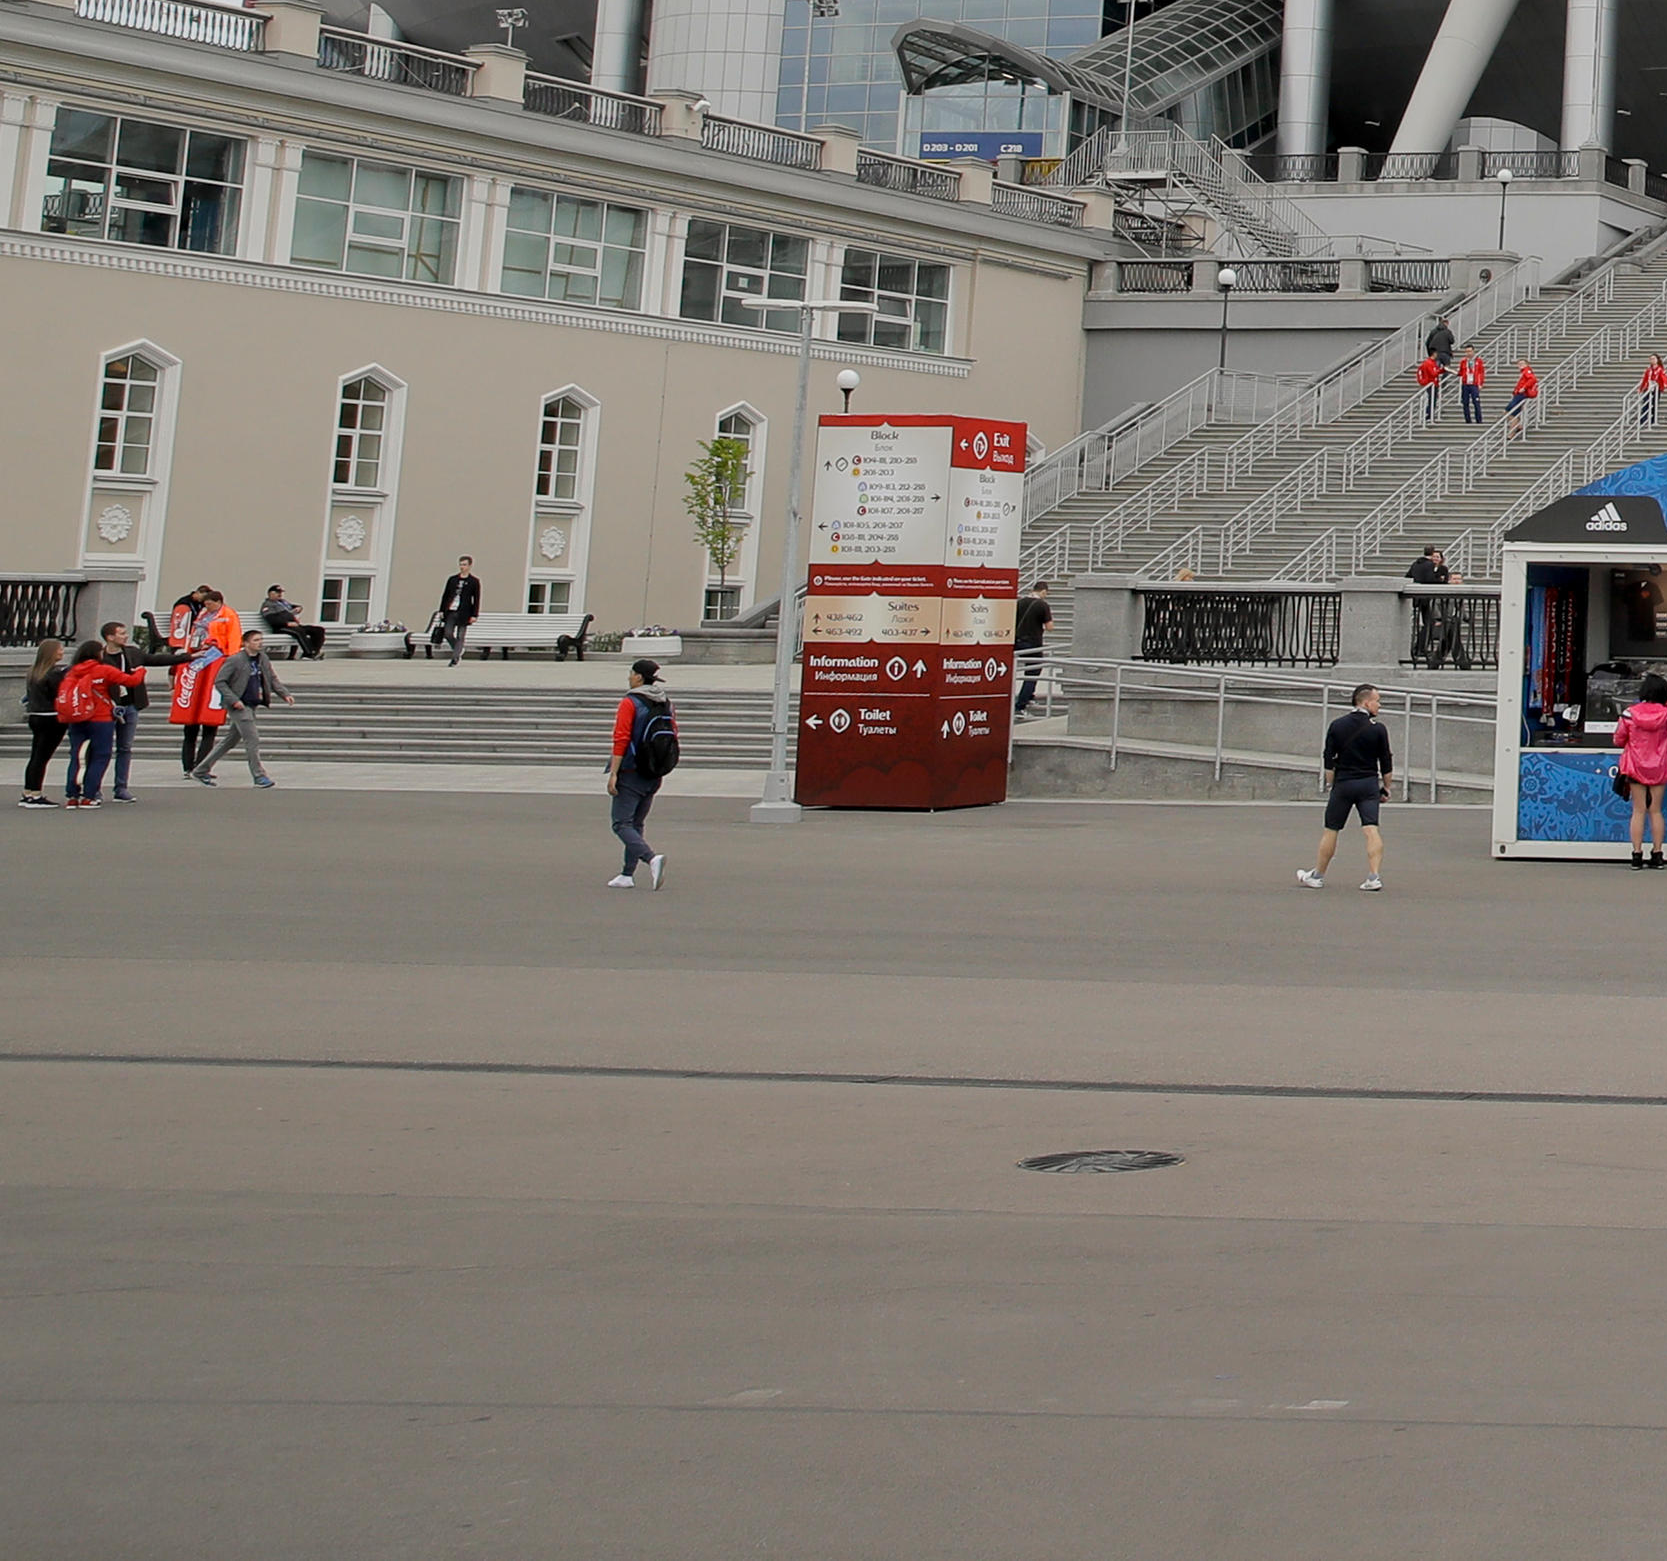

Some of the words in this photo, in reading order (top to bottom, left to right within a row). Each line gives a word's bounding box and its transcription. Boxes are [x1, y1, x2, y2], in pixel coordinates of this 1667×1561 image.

[870, 430, 900, 440] Block
[993, 432, 1011, 448] Exit
[1586, 519, 1628, 532] adidas
[809, 655, 879, 668] Information
[814, 670, 878, 683] Информация
[858, 708, 891, 721] Toilet
[857, 723, 897, 736] Туалеты
